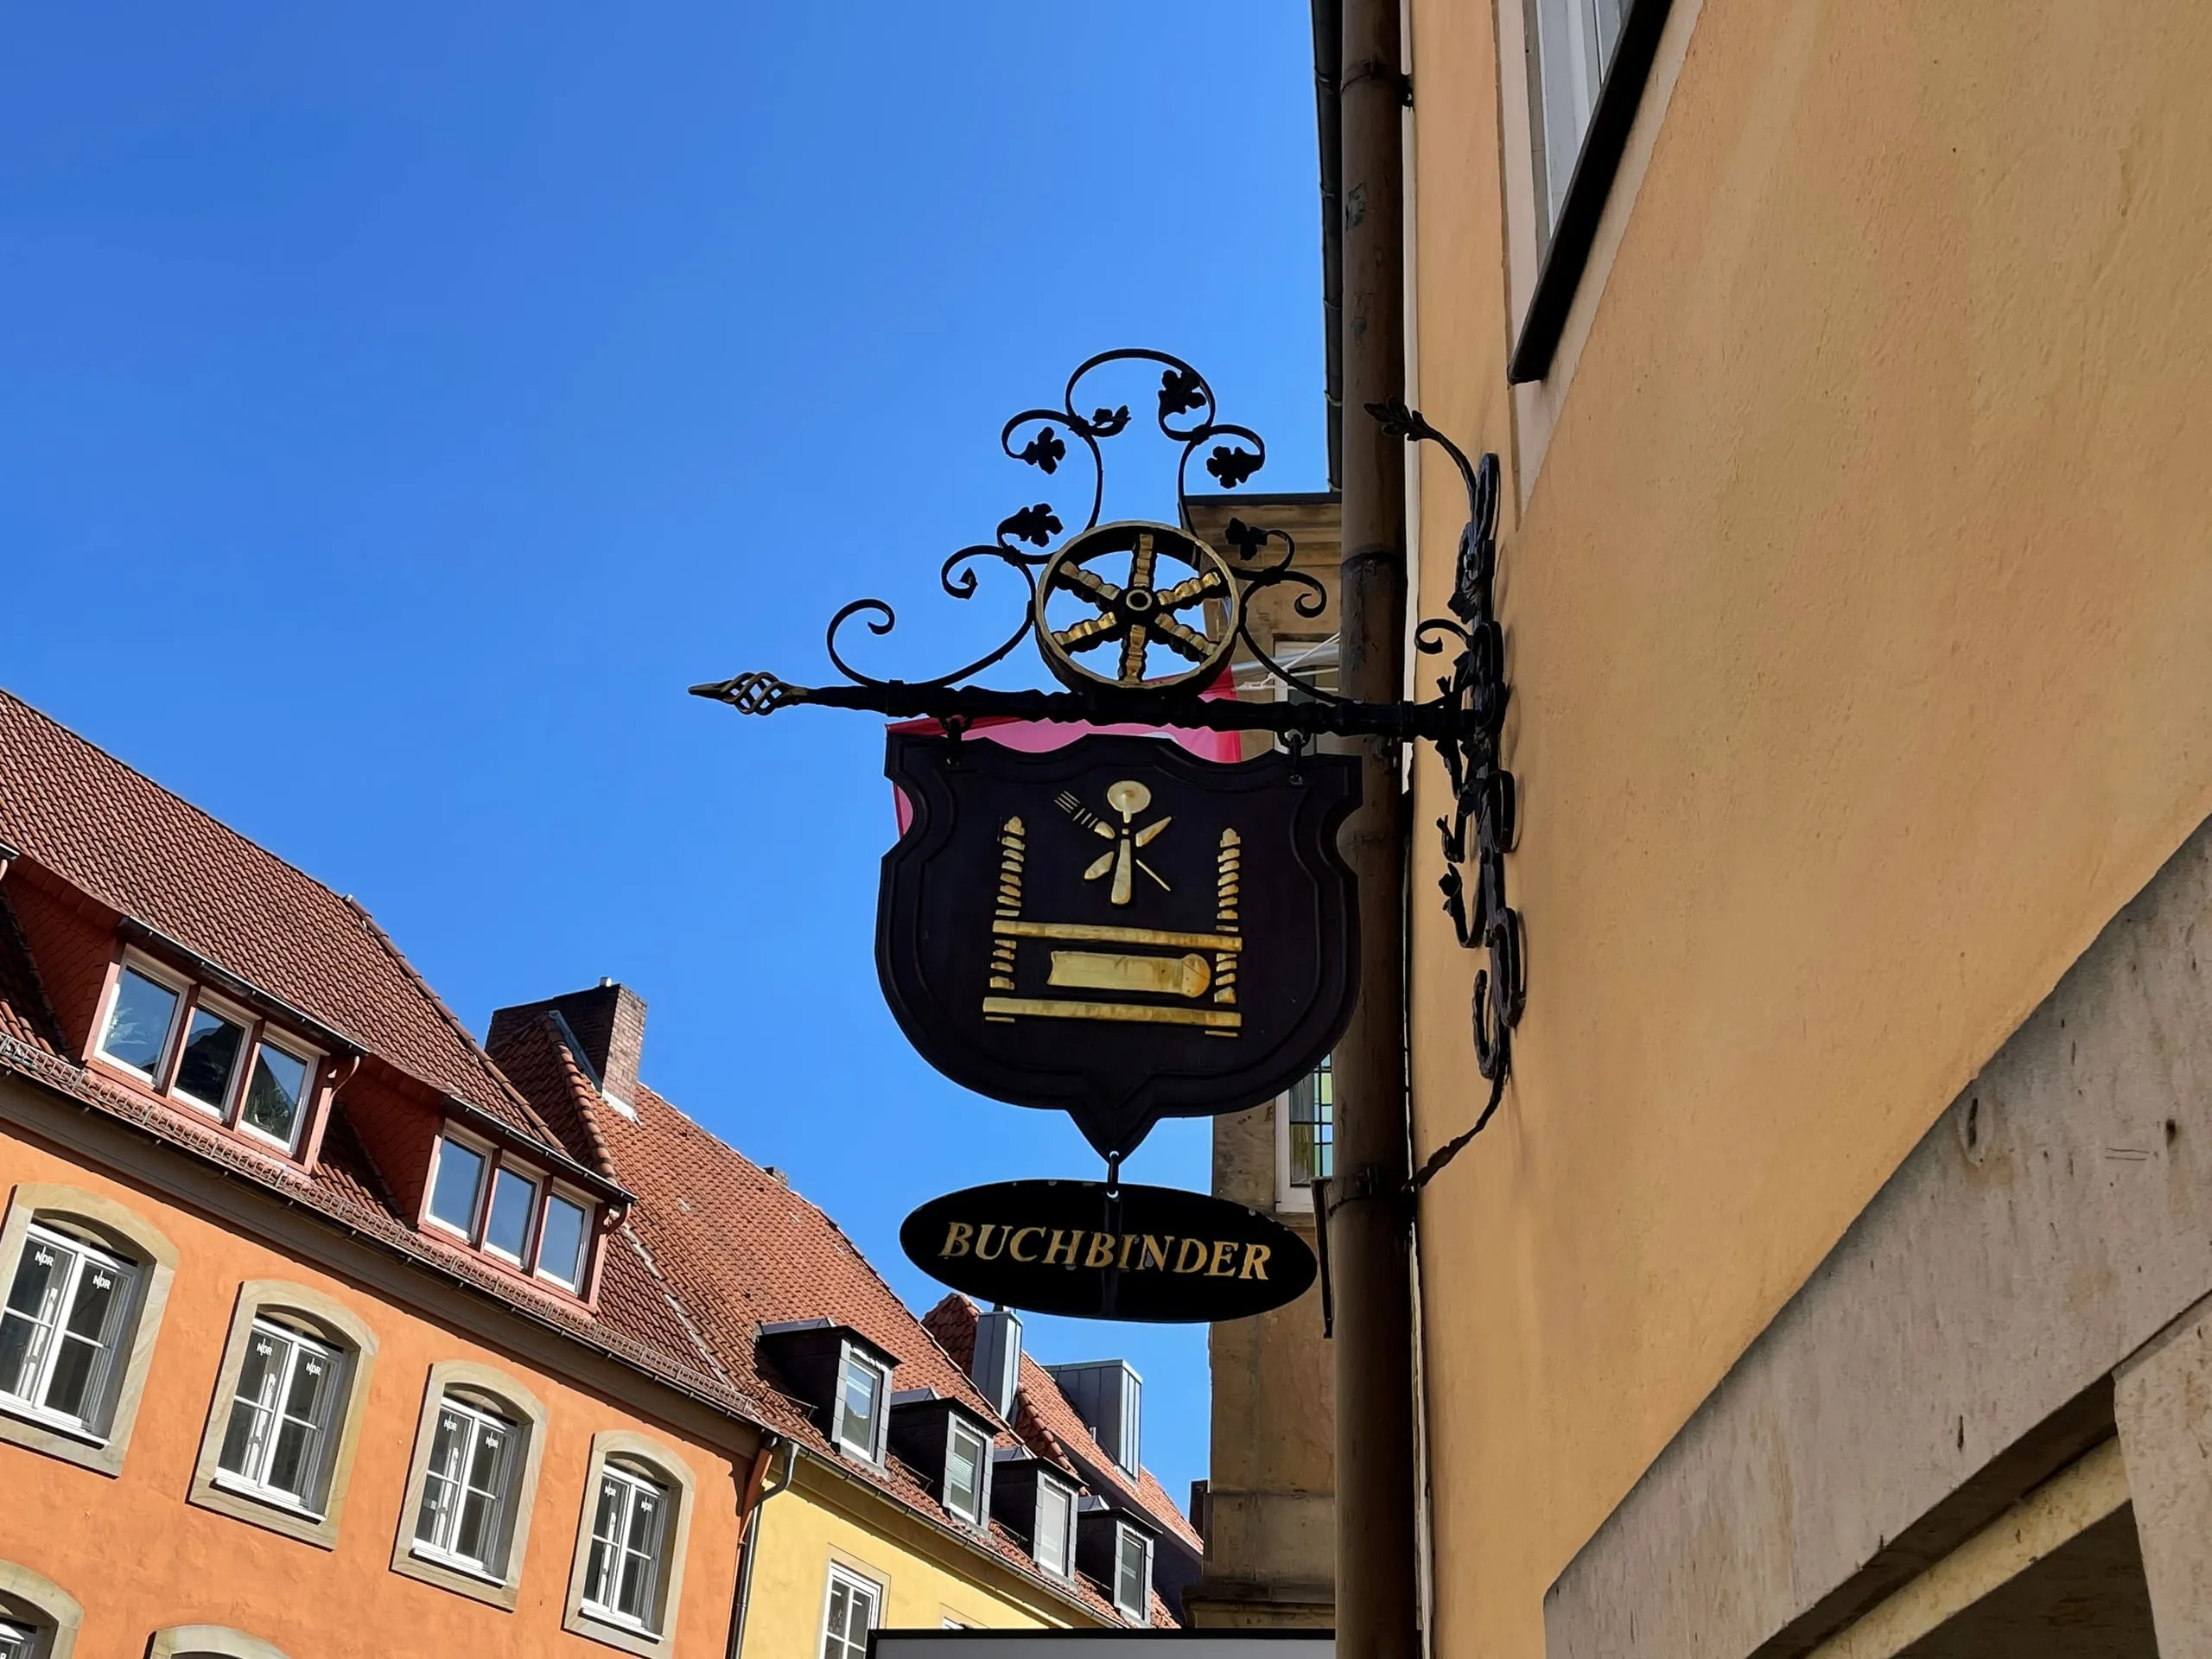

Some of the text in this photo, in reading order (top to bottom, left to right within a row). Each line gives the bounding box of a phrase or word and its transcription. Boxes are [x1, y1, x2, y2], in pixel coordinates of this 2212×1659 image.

[35, 1246, 54, 1266] NDR
[938, 1222, 1271, 1280] BUCHBINDER
[92, 1269, 111, 1290] NDR
